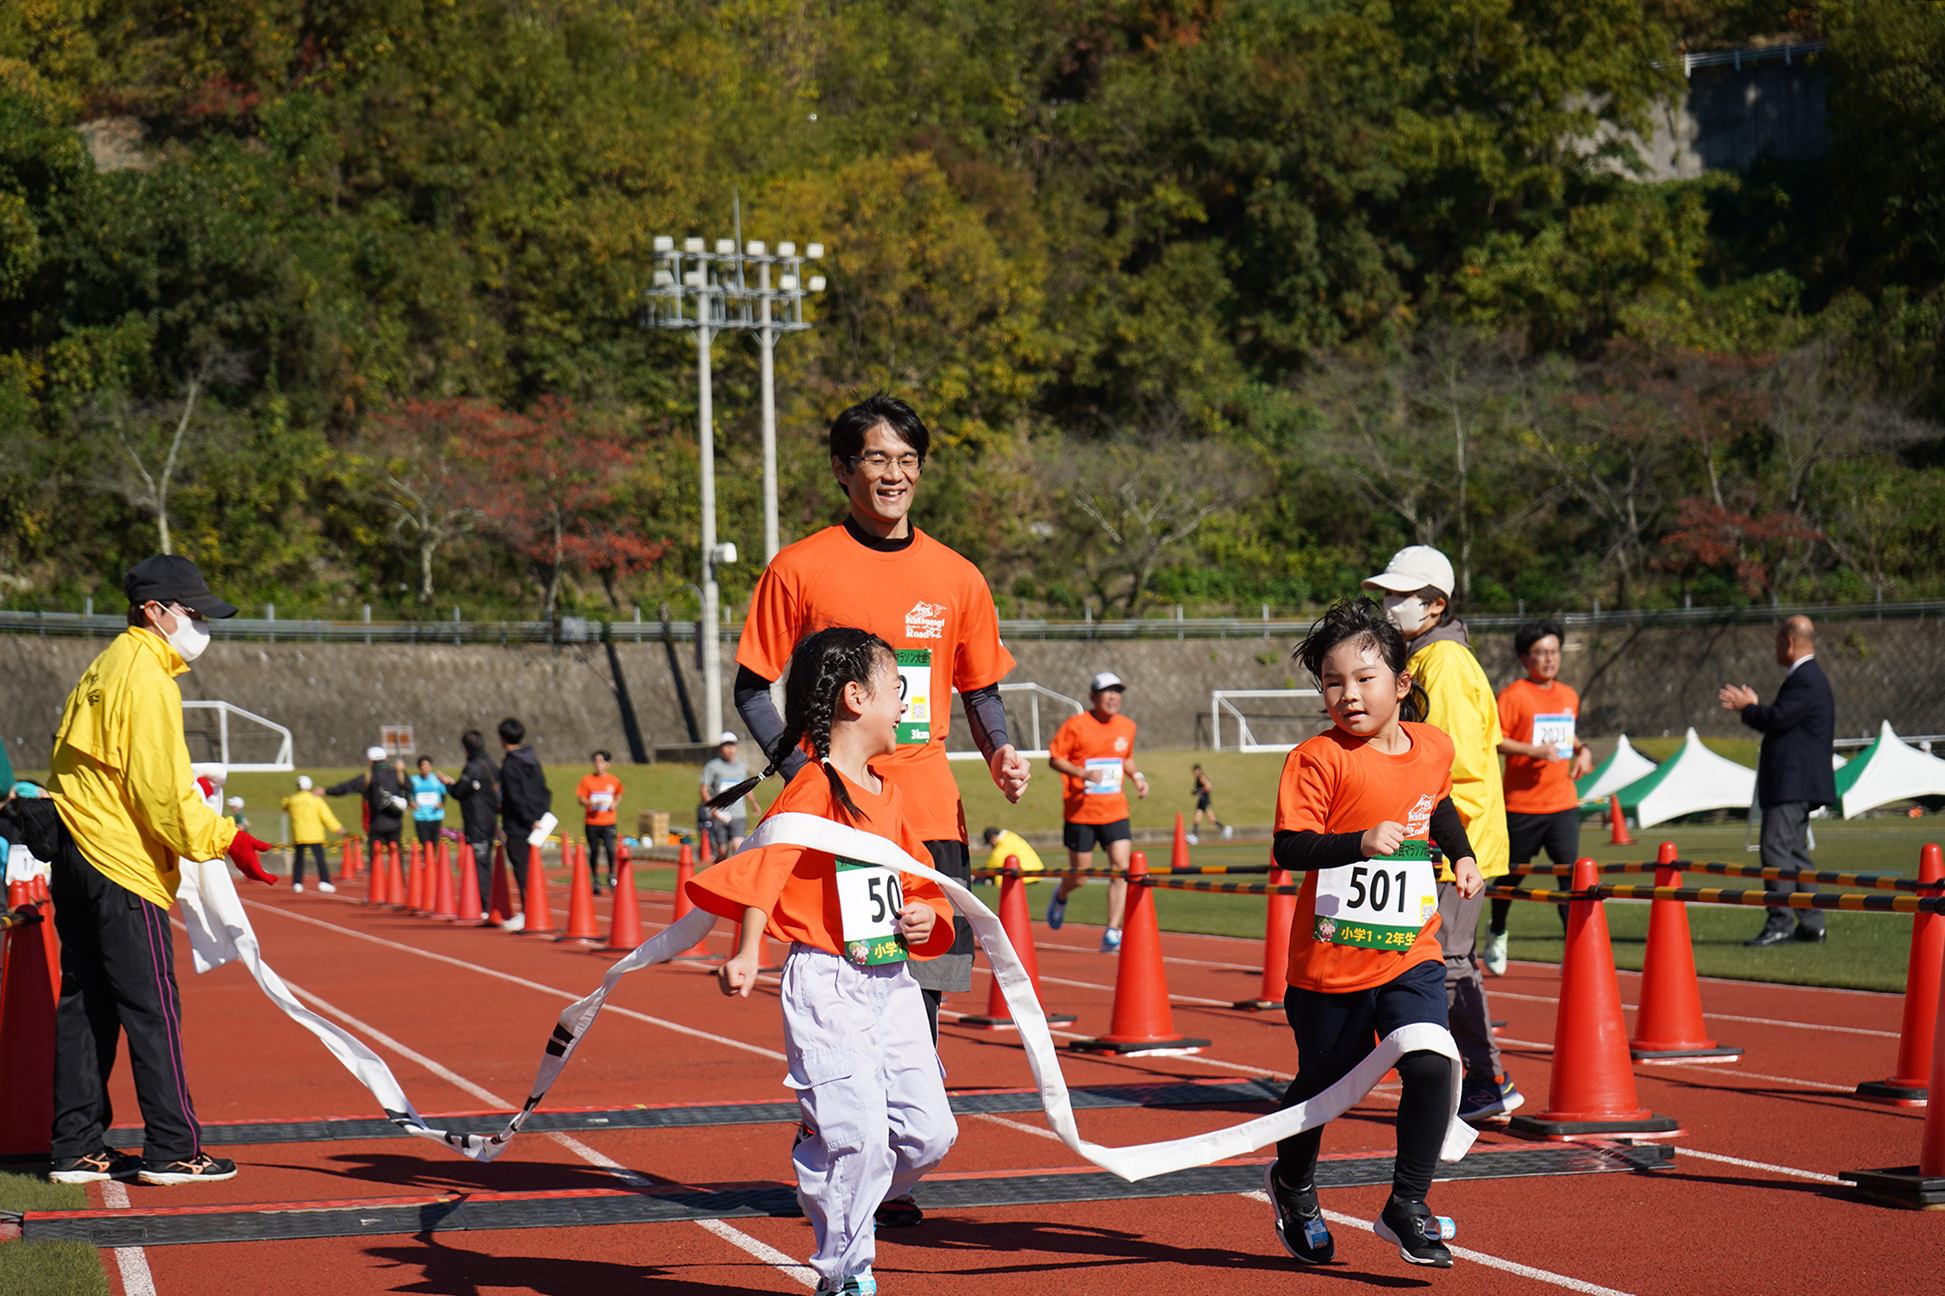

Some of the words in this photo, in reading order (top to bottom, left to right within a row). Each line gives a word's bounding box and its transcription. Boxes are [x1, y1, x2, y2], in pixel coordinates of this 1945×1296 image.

[906, 628, 929, 638] Road
[911, 729, 930, 740] 3km
[1346, 866, 1407, 913] 501
[1341, 926, 1417, 947] 小学1・2年生
